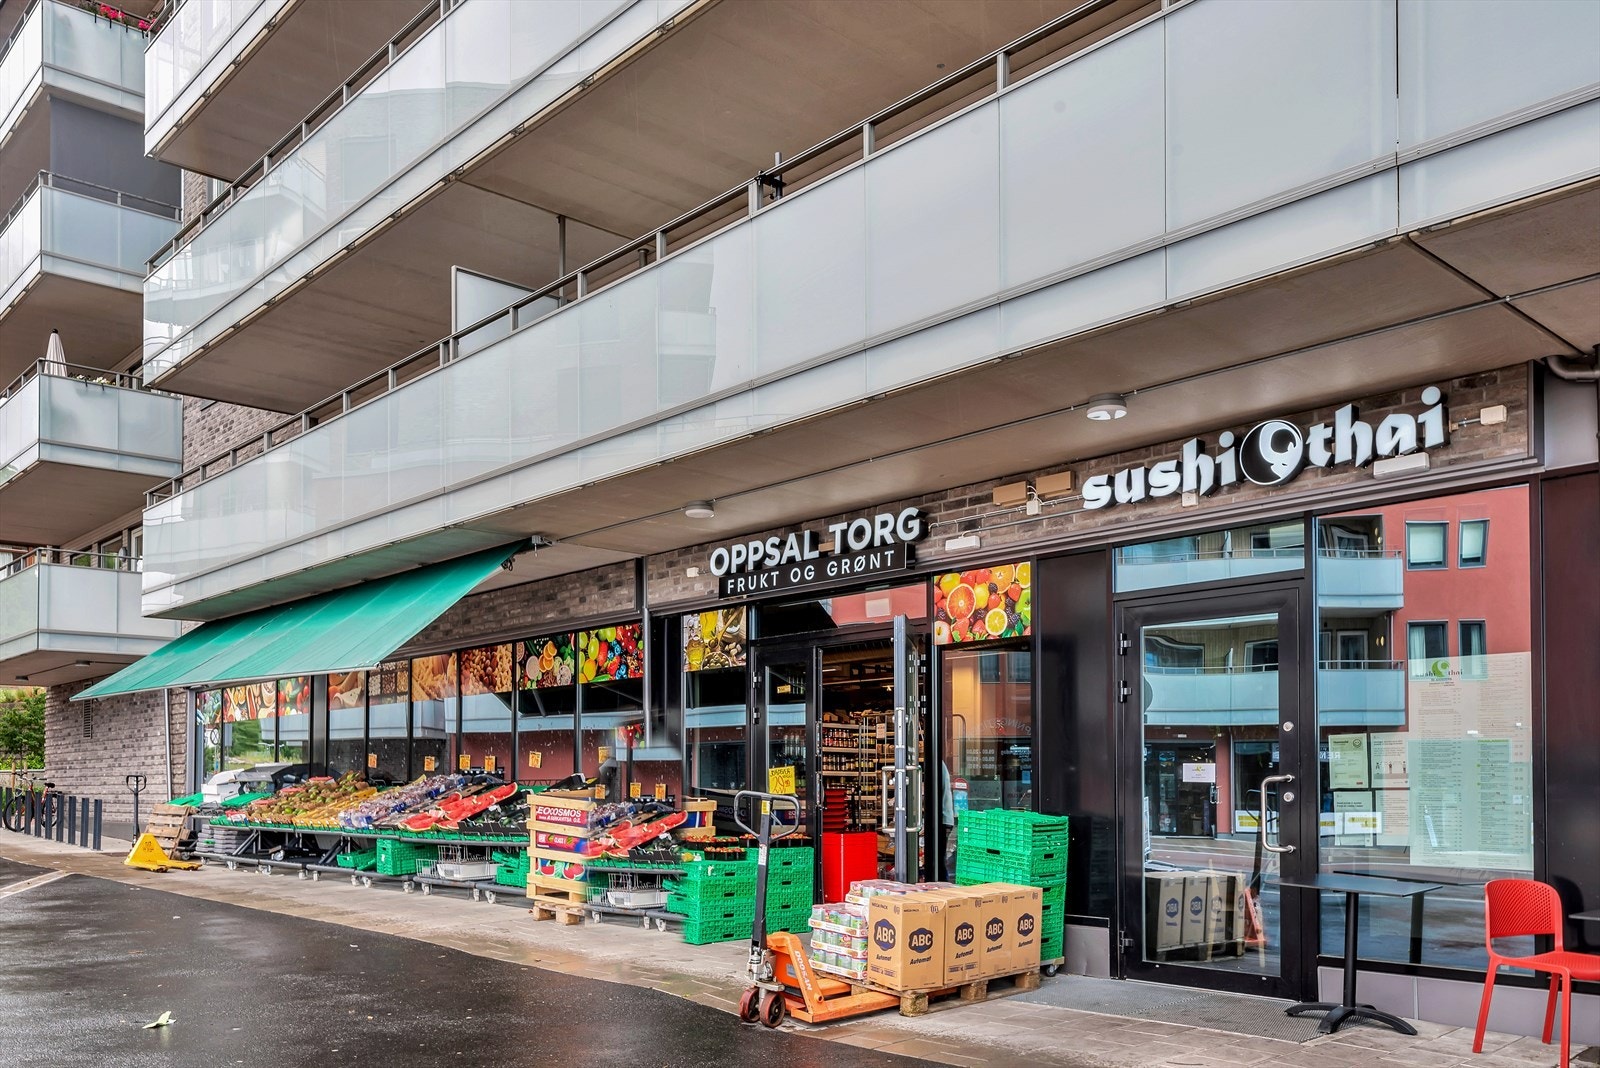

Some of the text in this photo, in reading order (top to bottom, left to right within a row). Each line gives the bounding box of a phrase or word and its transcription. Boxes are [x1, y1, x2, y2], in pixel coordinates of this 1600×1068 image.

[1082, 386, 1444, 509] sushi thai
[709, 507, 922, 578] OPPSAL TORG
[727, 550, 895, 595] FRUKT OG GRØNT
[988, 923, 1002, 936] ABC
[1019, 918, 1033, 930] ABC
[876, 926, 894, 944] ABC
[911, 934, 932, 947] ABC
[957, 928, 973, 941] ABC
[910, 956, 931, 965] Automat
[955, 949, 974, 959] Automat
[794, 950, 813, 991] DOOSAN
